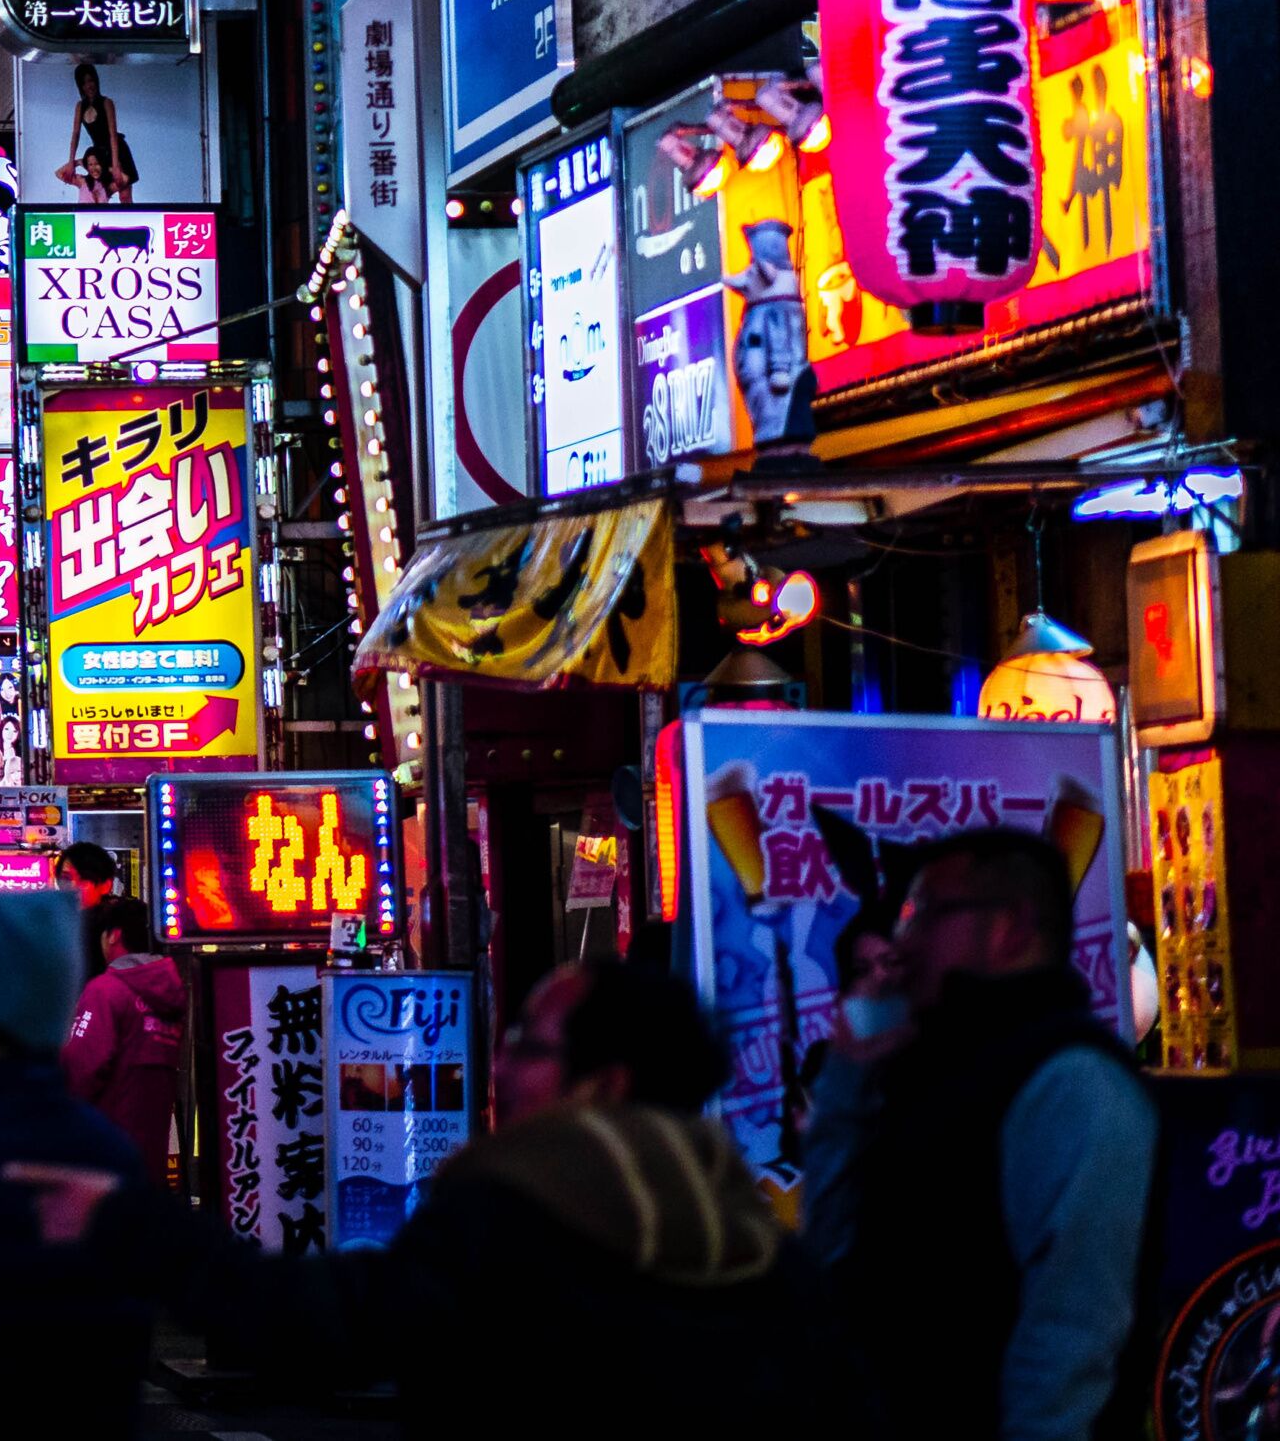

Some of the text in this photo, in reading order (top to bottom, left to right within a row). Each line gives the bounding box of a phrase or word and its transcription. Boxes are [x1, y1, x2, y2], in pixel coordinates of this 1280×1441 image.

[24, 0, 181, 28] 第一大滝ビル
[365, 20, 397, 208] 劇場通り一番街
[30, 221, 52, 245] 肉
[167, 223, 211, 239] イタリ
[47, 245, 74, 256] バル
[174, 240, 203, 256] アン
[39, 267, 202, 300] XROSS
[61, 306, 183, 339] CASA
[60, 391, 210, 488] キラリ
[60, 451, 231, 600] 出会い
[133, 548, 242, 630] カフェ
[72, 722, 189, 750] 受付3F
[759, 773, 1046, 828] ガールズバー
[248, 794, 366, 912] なん
